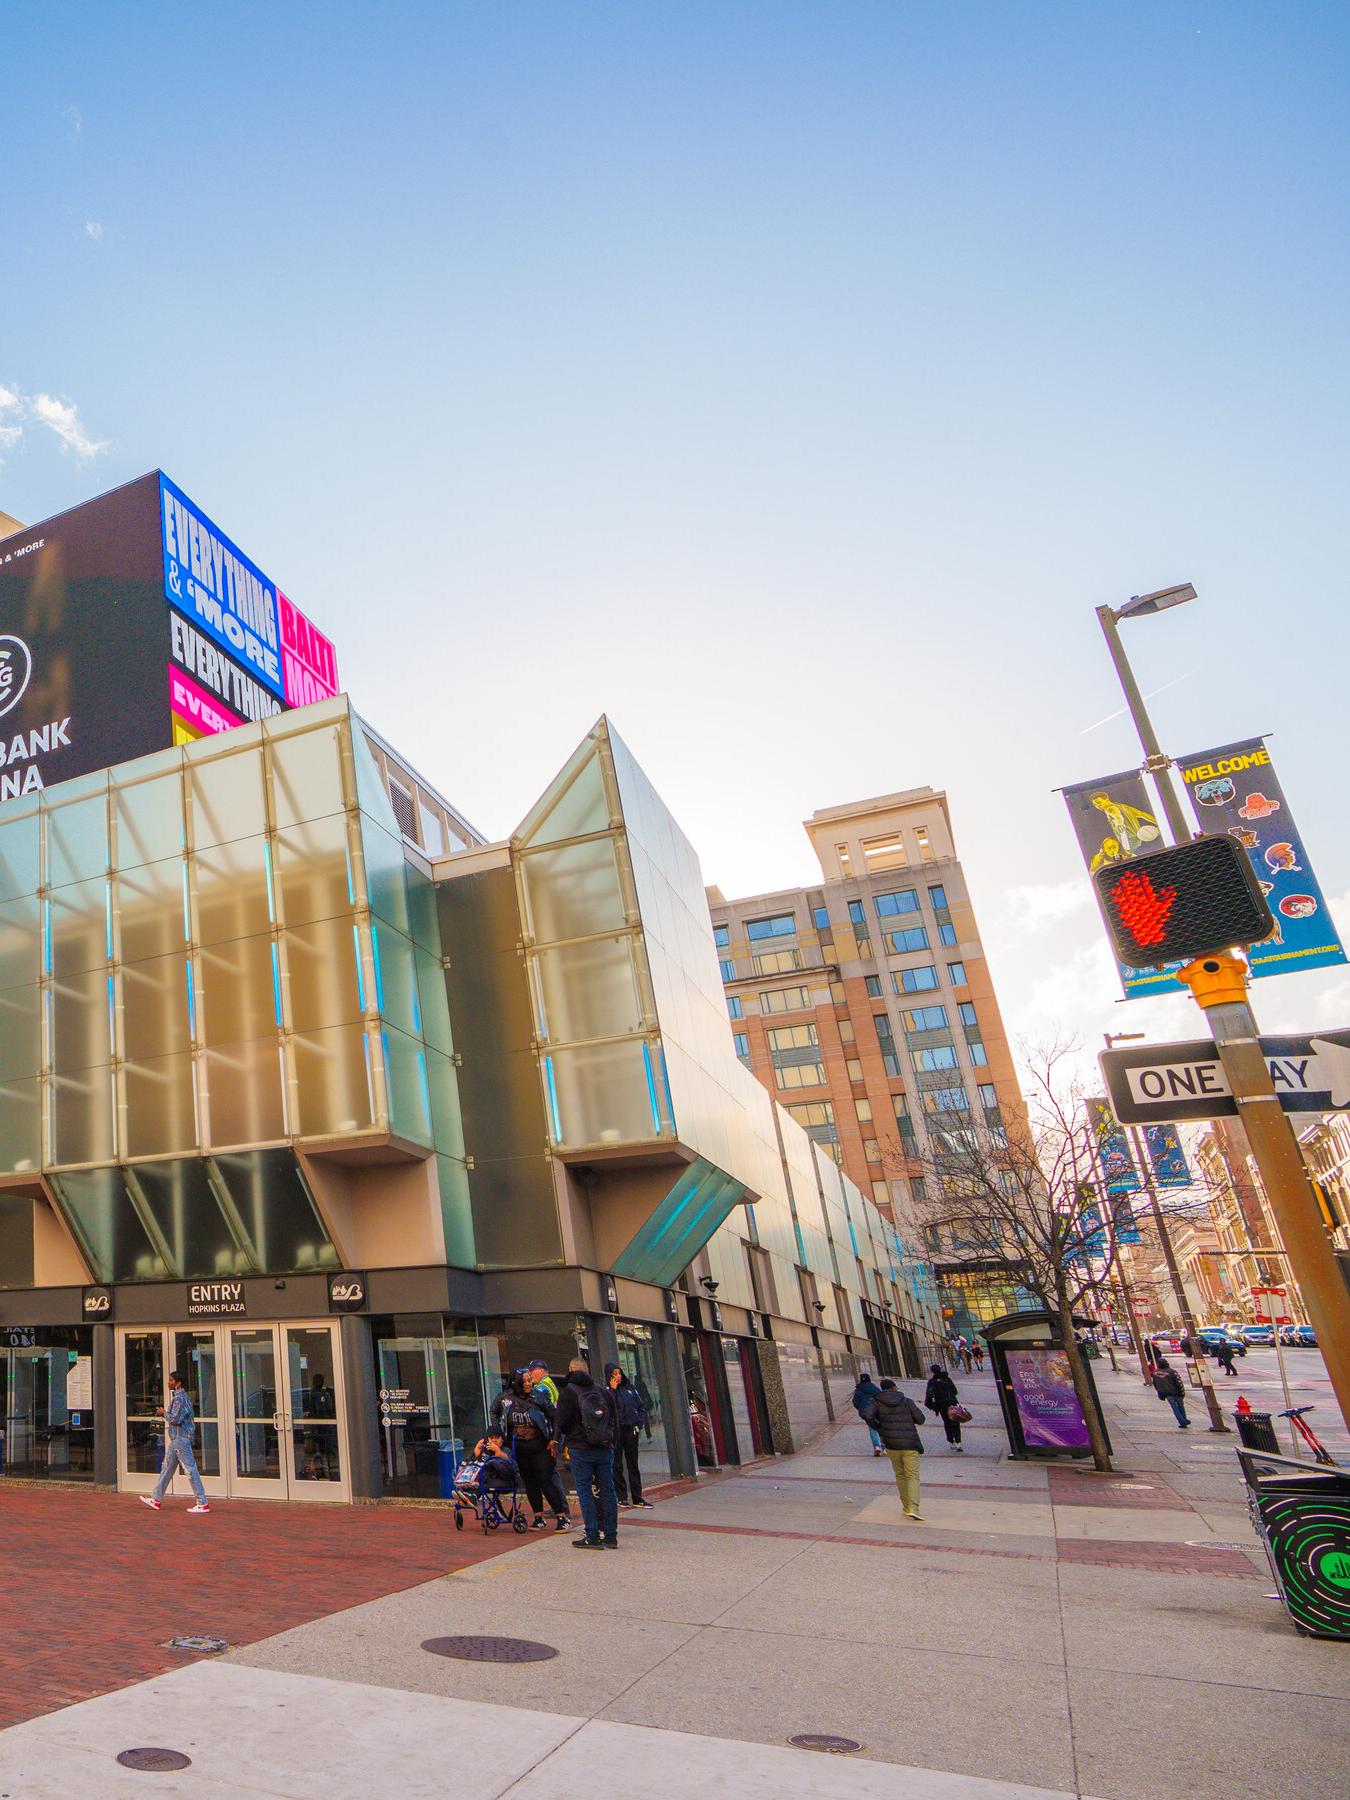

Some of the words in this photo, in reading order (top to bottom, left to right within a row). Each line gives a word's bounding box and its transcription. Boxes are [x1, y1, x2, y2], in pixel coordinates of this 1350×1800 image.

[4, 554, 12, 563] &
[164, 487, 279, 654] EVERYTHING
[169, 560, 182, 598] &
[280, 594, 336, 691] BALTI
[1181, 750, 1271, 784] WELCOME
[1250, 944, 1340, 965] CIAATOURNAMENT.ORG
[1139, 1064, 1225, 1099] ONE
[1268, 1060, 1309, 1089] AY
[191, 1283, 242, 1302] ENTRY
[189, 1304, 220, 1313] HOPKINS
[221, 1303, 246, 1312] PLAZA
[1023, 1393, 1044, 1402] good
[1030, 1399, 1058, 1407] energy
